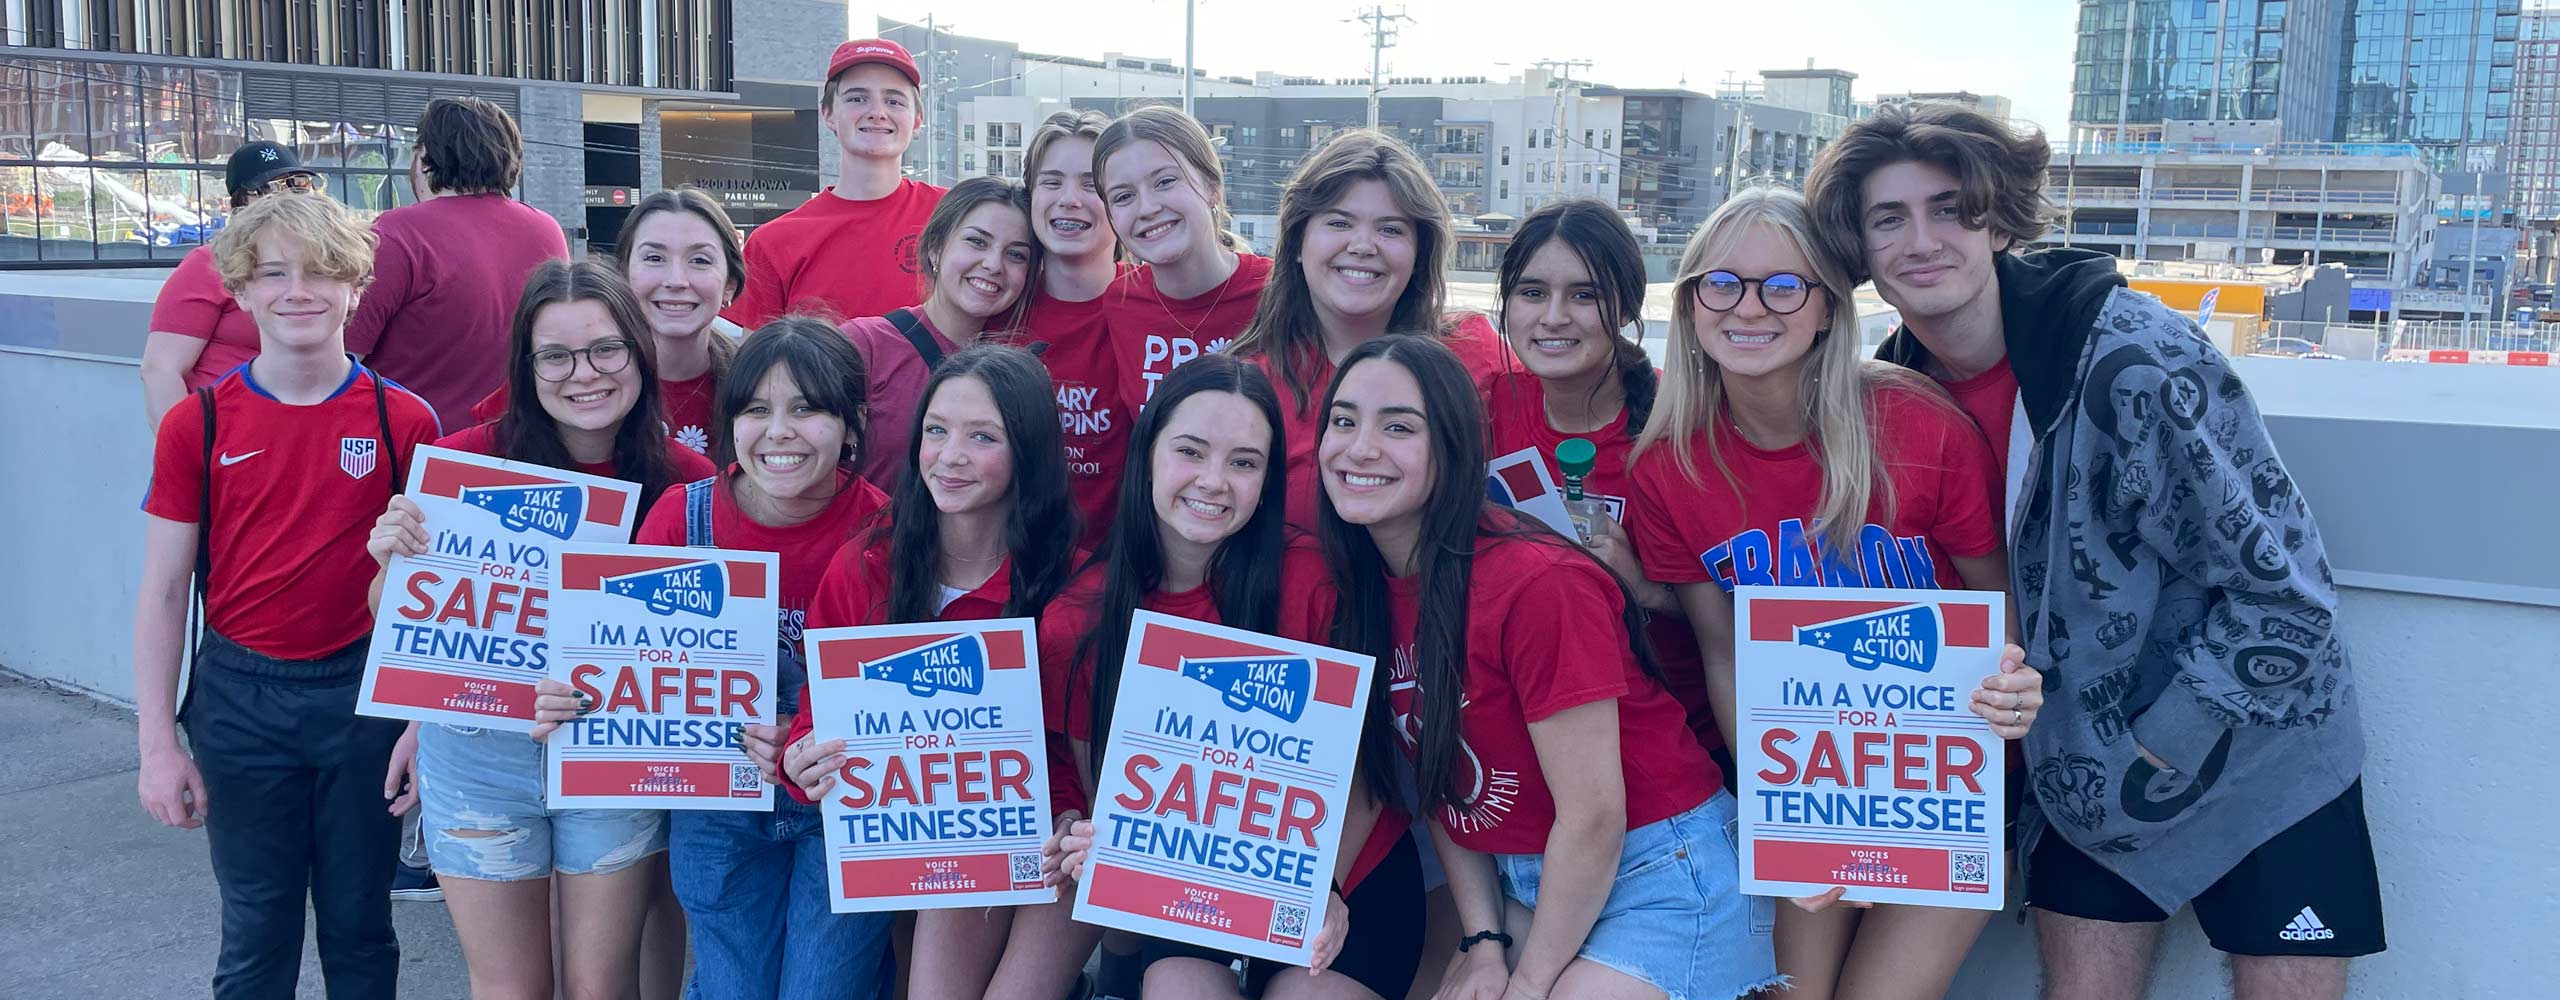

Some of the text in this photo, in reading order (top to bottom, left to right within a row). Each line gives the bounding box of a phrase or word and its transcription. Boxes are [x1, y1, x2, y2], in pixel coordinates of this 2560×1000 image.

[856, 46, 895, 55] Supreme
[725, 192, 766, 202] PARKING
[728, 180, 791, 192] BROADWAY
[1058, 408, 1112, 436] PINS
[344, 440, 375, 455] USA
[524, 490, 563, 509] TAKE
[508, 504, 569, 534] ACTION
[436, 530, 473, 557] I'M
[479, 539, 497, 561] A
[481, 562, 530, 582] FOR A
[663, 569, 701, 588] TAKE
[652, 588, 712, 611] ACTION
[590, 621, 738, 650] I'M A VOICE
[1866, 614, 1910, 637] TAKE
[639, 649, 689, 664] FOR A
[921, 644, 960, 667] TAKE
[1853, 638, 1924, 664] ACTION
[912, 666, 973, 688] ACTION
[1247, 663, 1289, 685] TAKE
[2252, 657, 2293, 678] FOX
[464, 681, 497, 691] VOICES
[570, 663, 762, 718] SAFER
[1231, 678, 1295, 714] ACTION
[1783, 677, 1955, 711] I'M A VOICE
[443, 698, 509, 713] TENNESSEE
[854, 706, 1003, 735] I'M A VOICE
[1838, 710, 1897, 727] FOR A
[564, 717, 760, 748] TENNESSE
[905, 734, 956, 749] FOR A
[1154, 706, 1313, 764] I'M A VOICE
[1202, 747, 1255, 772] FOR A
[1756, 727, 1987, 795] SAFER
[630, 783, 696, 793] TENNESSEE
[839, 749, 1034, 810] SAFER
[1114, 753, 1328, 850] SAFER
[1447, 767, 1520, 834] DEPARTMENT
[1756, 789, 1986, 833] TENNESSEE
[839, 806, 1037, 844] TENNESSEE
[1108, 813, 1318, 888] TENNESSEE
[1850, 850, 1889, 859] VOICES
[925, 861, 958, 869] VOICES
[1850, 863, 1890, 873] SAFER
[910, 880, 977, 891] TENNESSEE
[1832, 870, 1909, 883] TENNESSEE
[1184, 887, 1219, 901] VOICES
[1161, 905, 1232, 928] TENNESSEE
[2279, 928, 2335, 941] adidas
